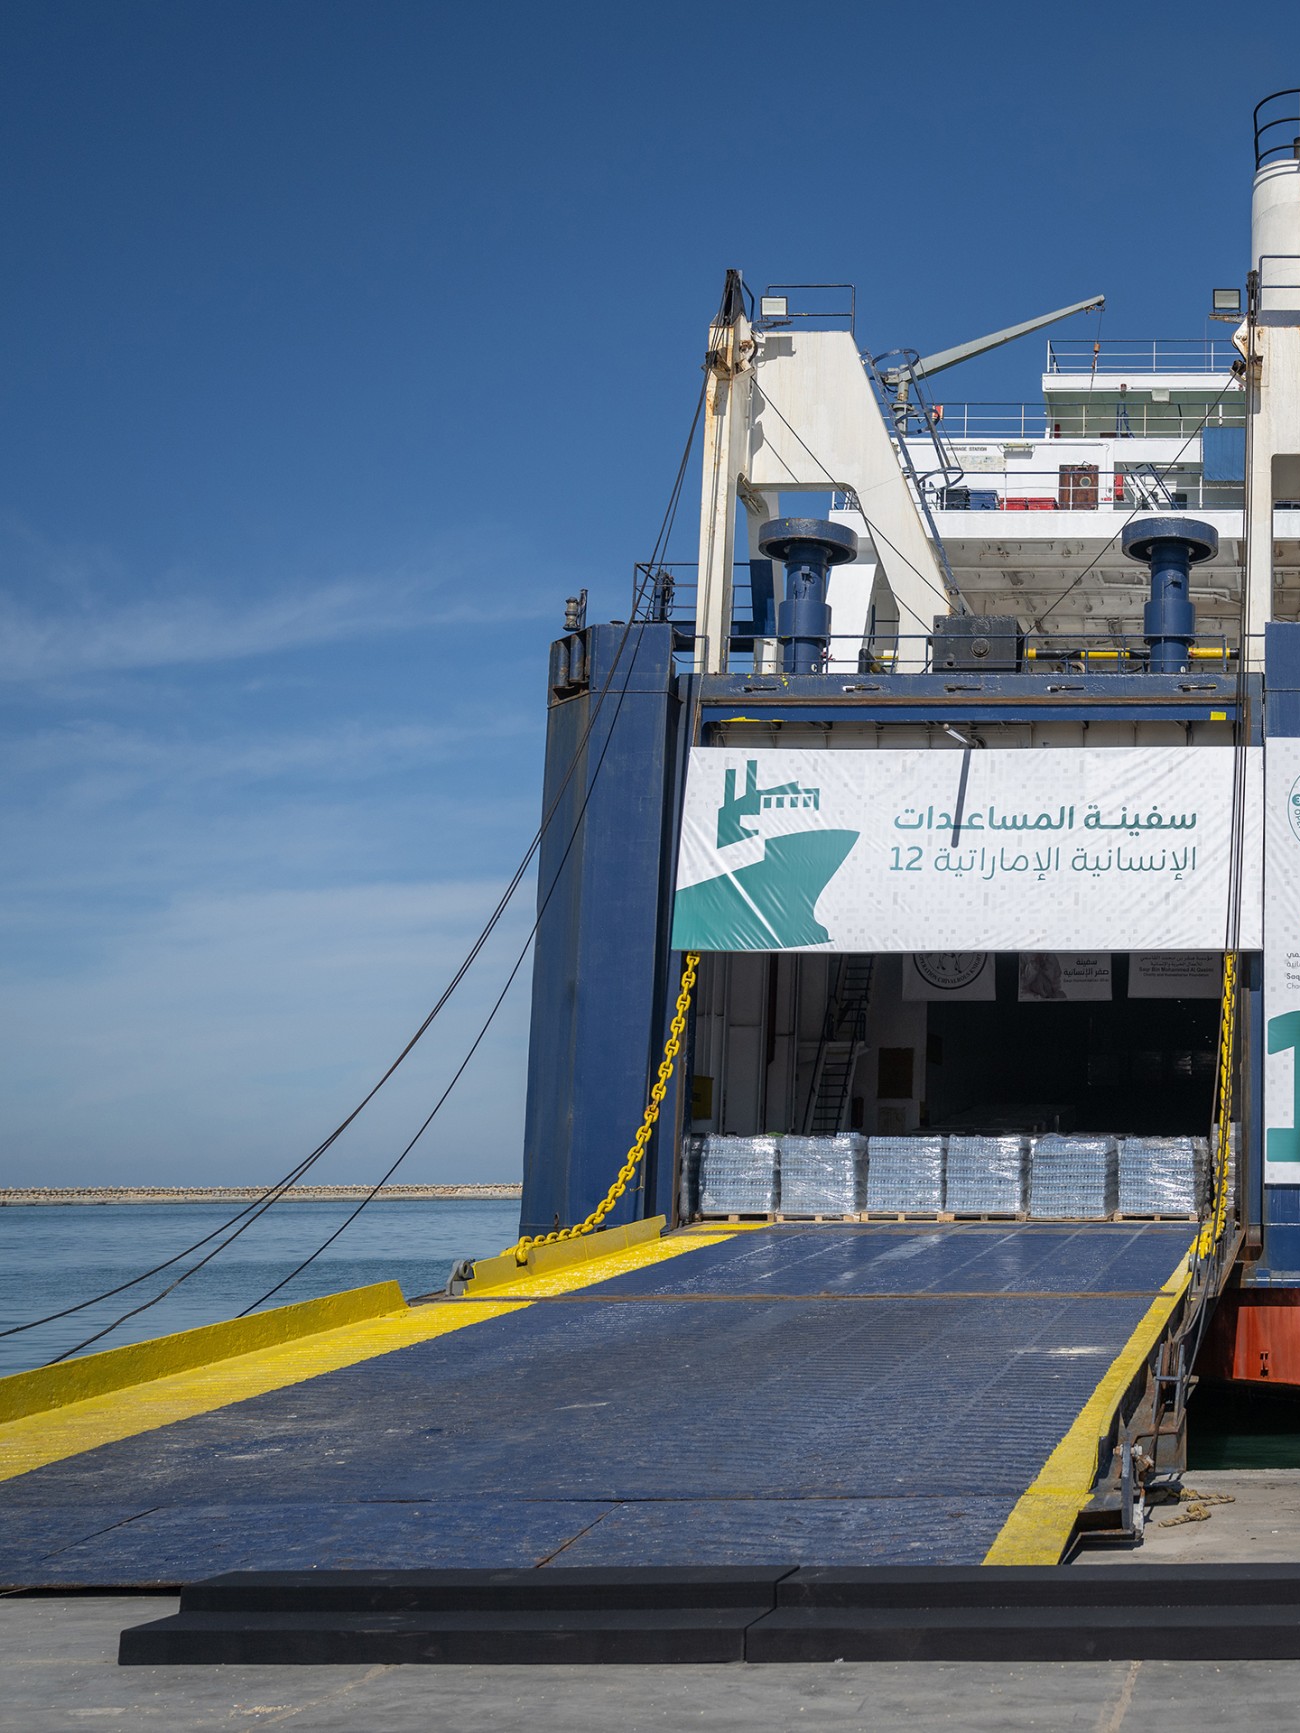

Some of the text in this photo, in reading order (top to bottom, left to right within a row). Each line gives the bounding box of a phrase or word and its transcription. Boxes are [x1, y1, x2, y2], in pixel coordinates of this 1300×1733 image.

[894, 805, 1197, 837] سفينة المساعدات
[889, 846, 1197, 881] الإنسانية الإماراتية 12
